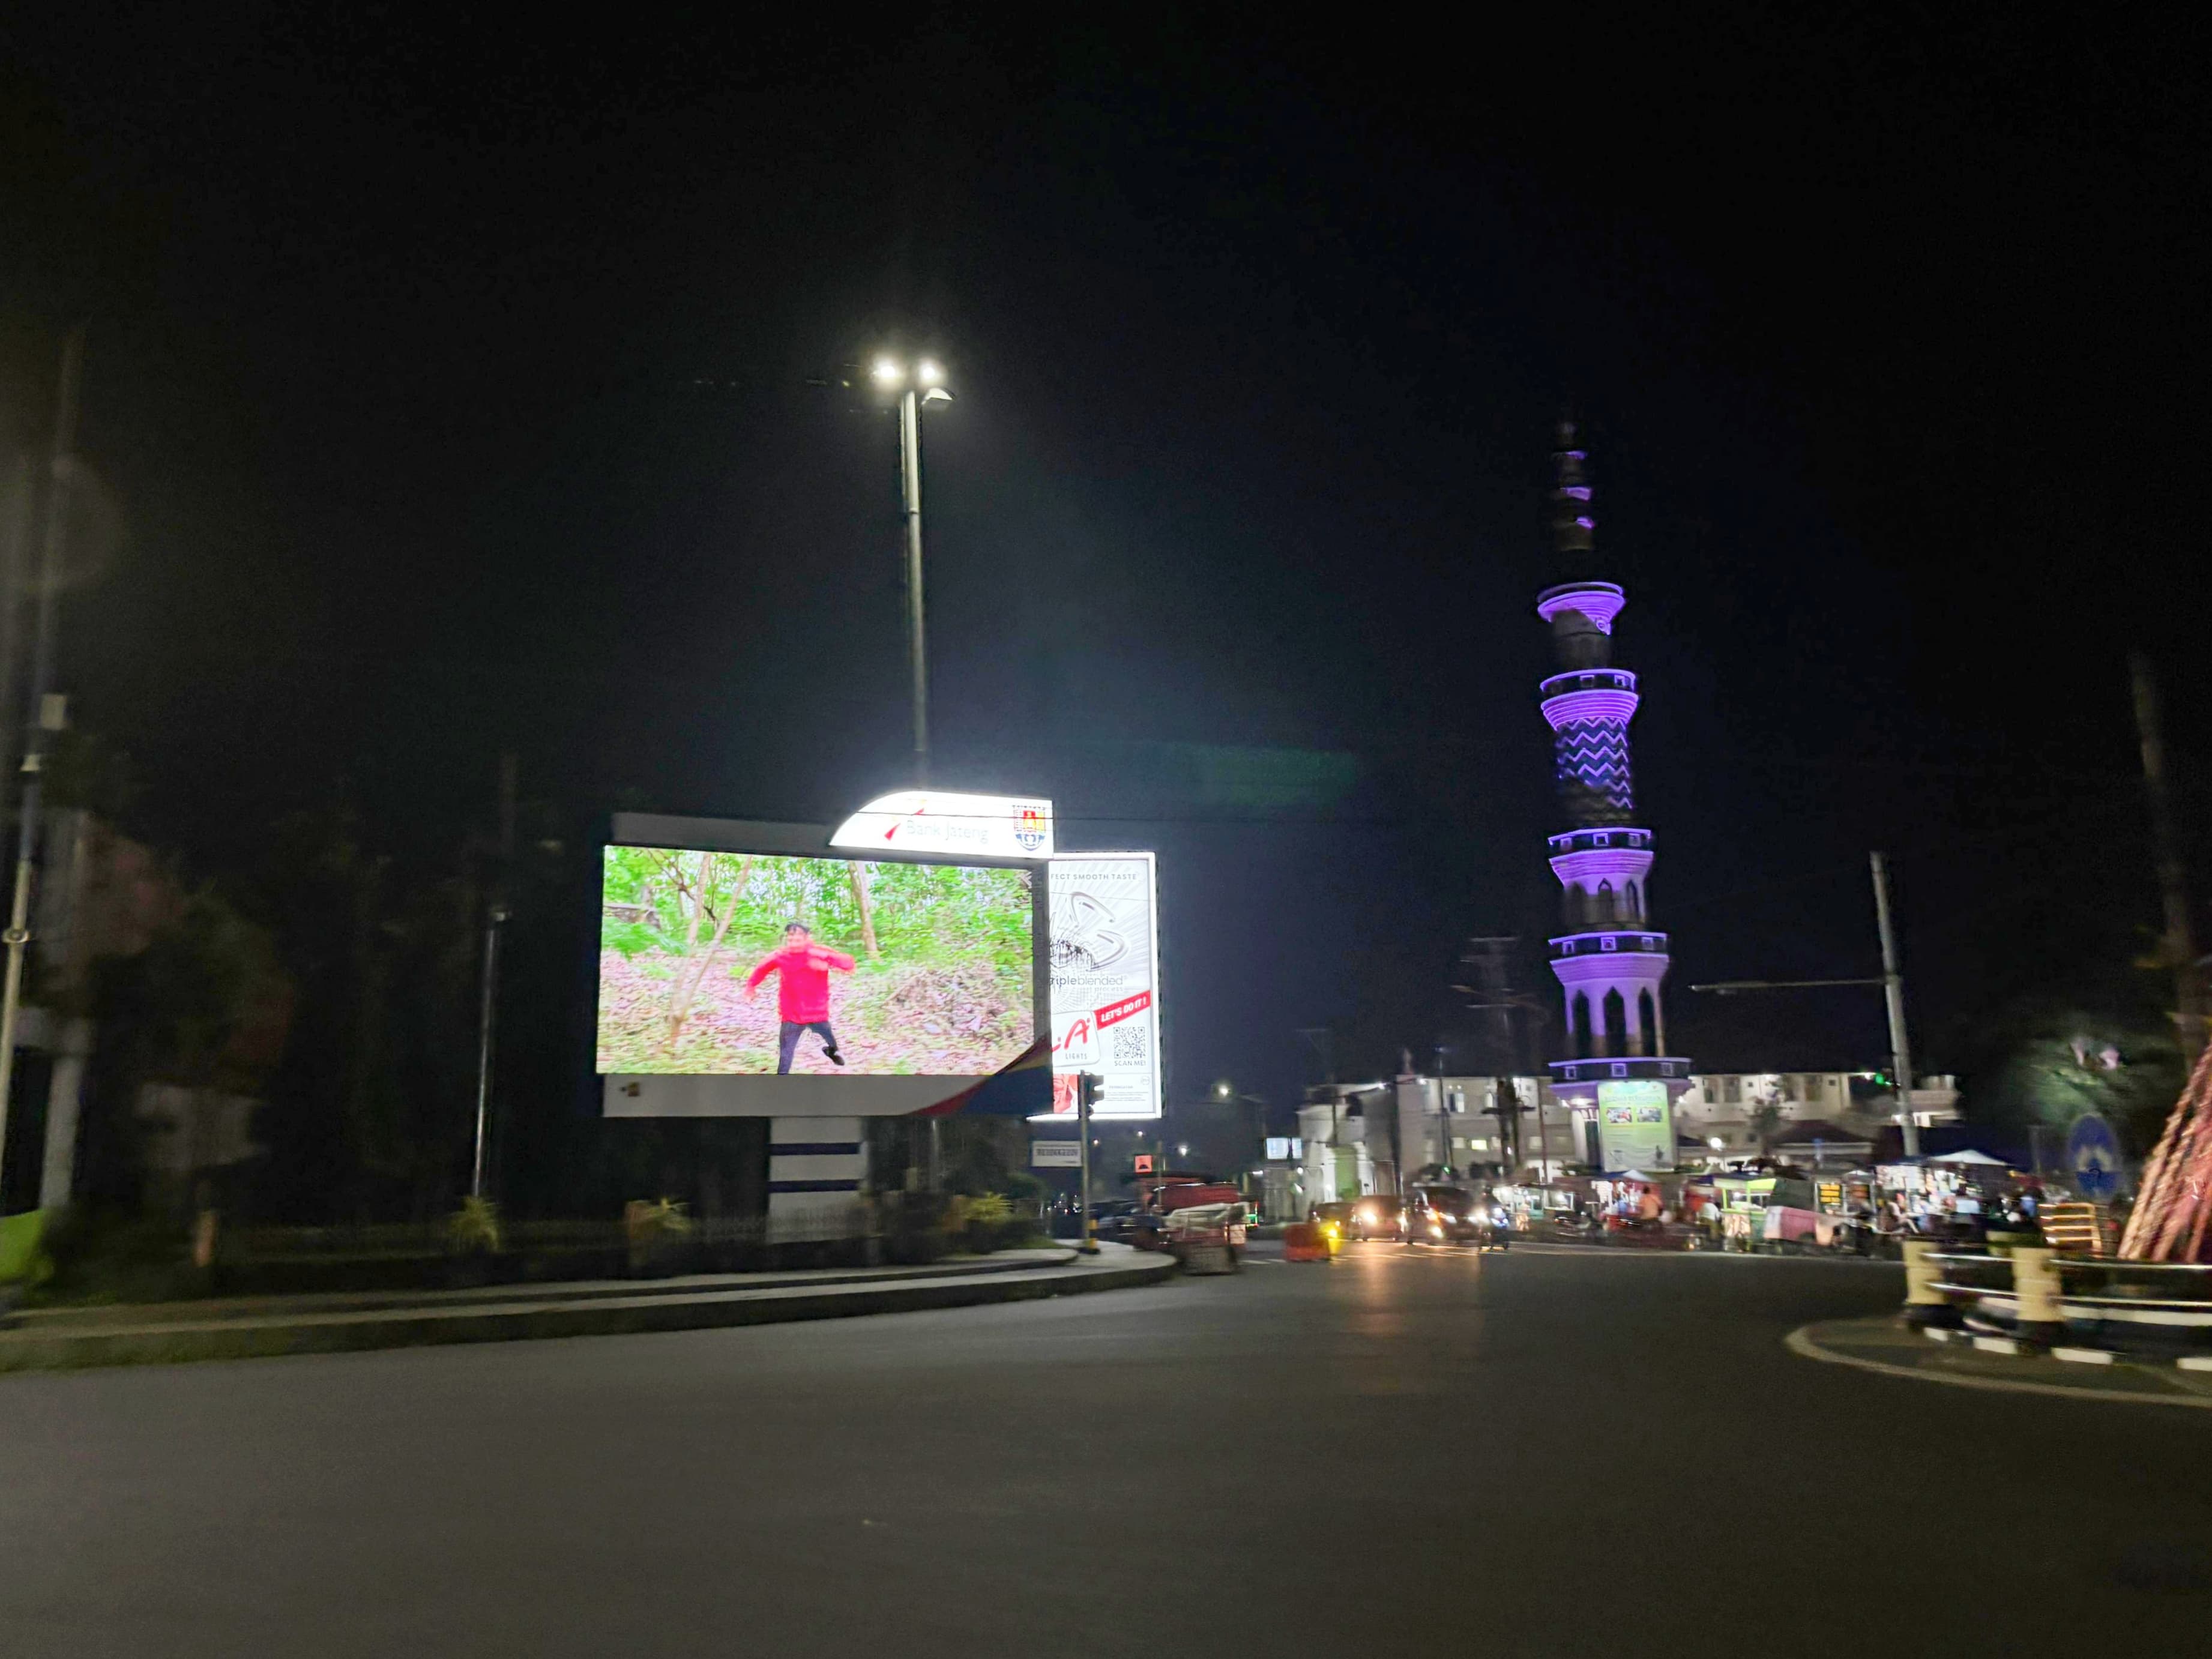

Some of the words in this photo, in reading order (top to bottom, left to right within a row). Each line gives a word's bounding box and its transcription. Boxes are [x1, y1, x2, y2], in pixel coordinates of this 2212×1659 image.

[906, 819, 941, 836] Bank
[944, 820, 990, 844] Jateng
[1101, 1007, 1122, 1023] LET'S
[1123, 1002, 1135, 1013] DO
